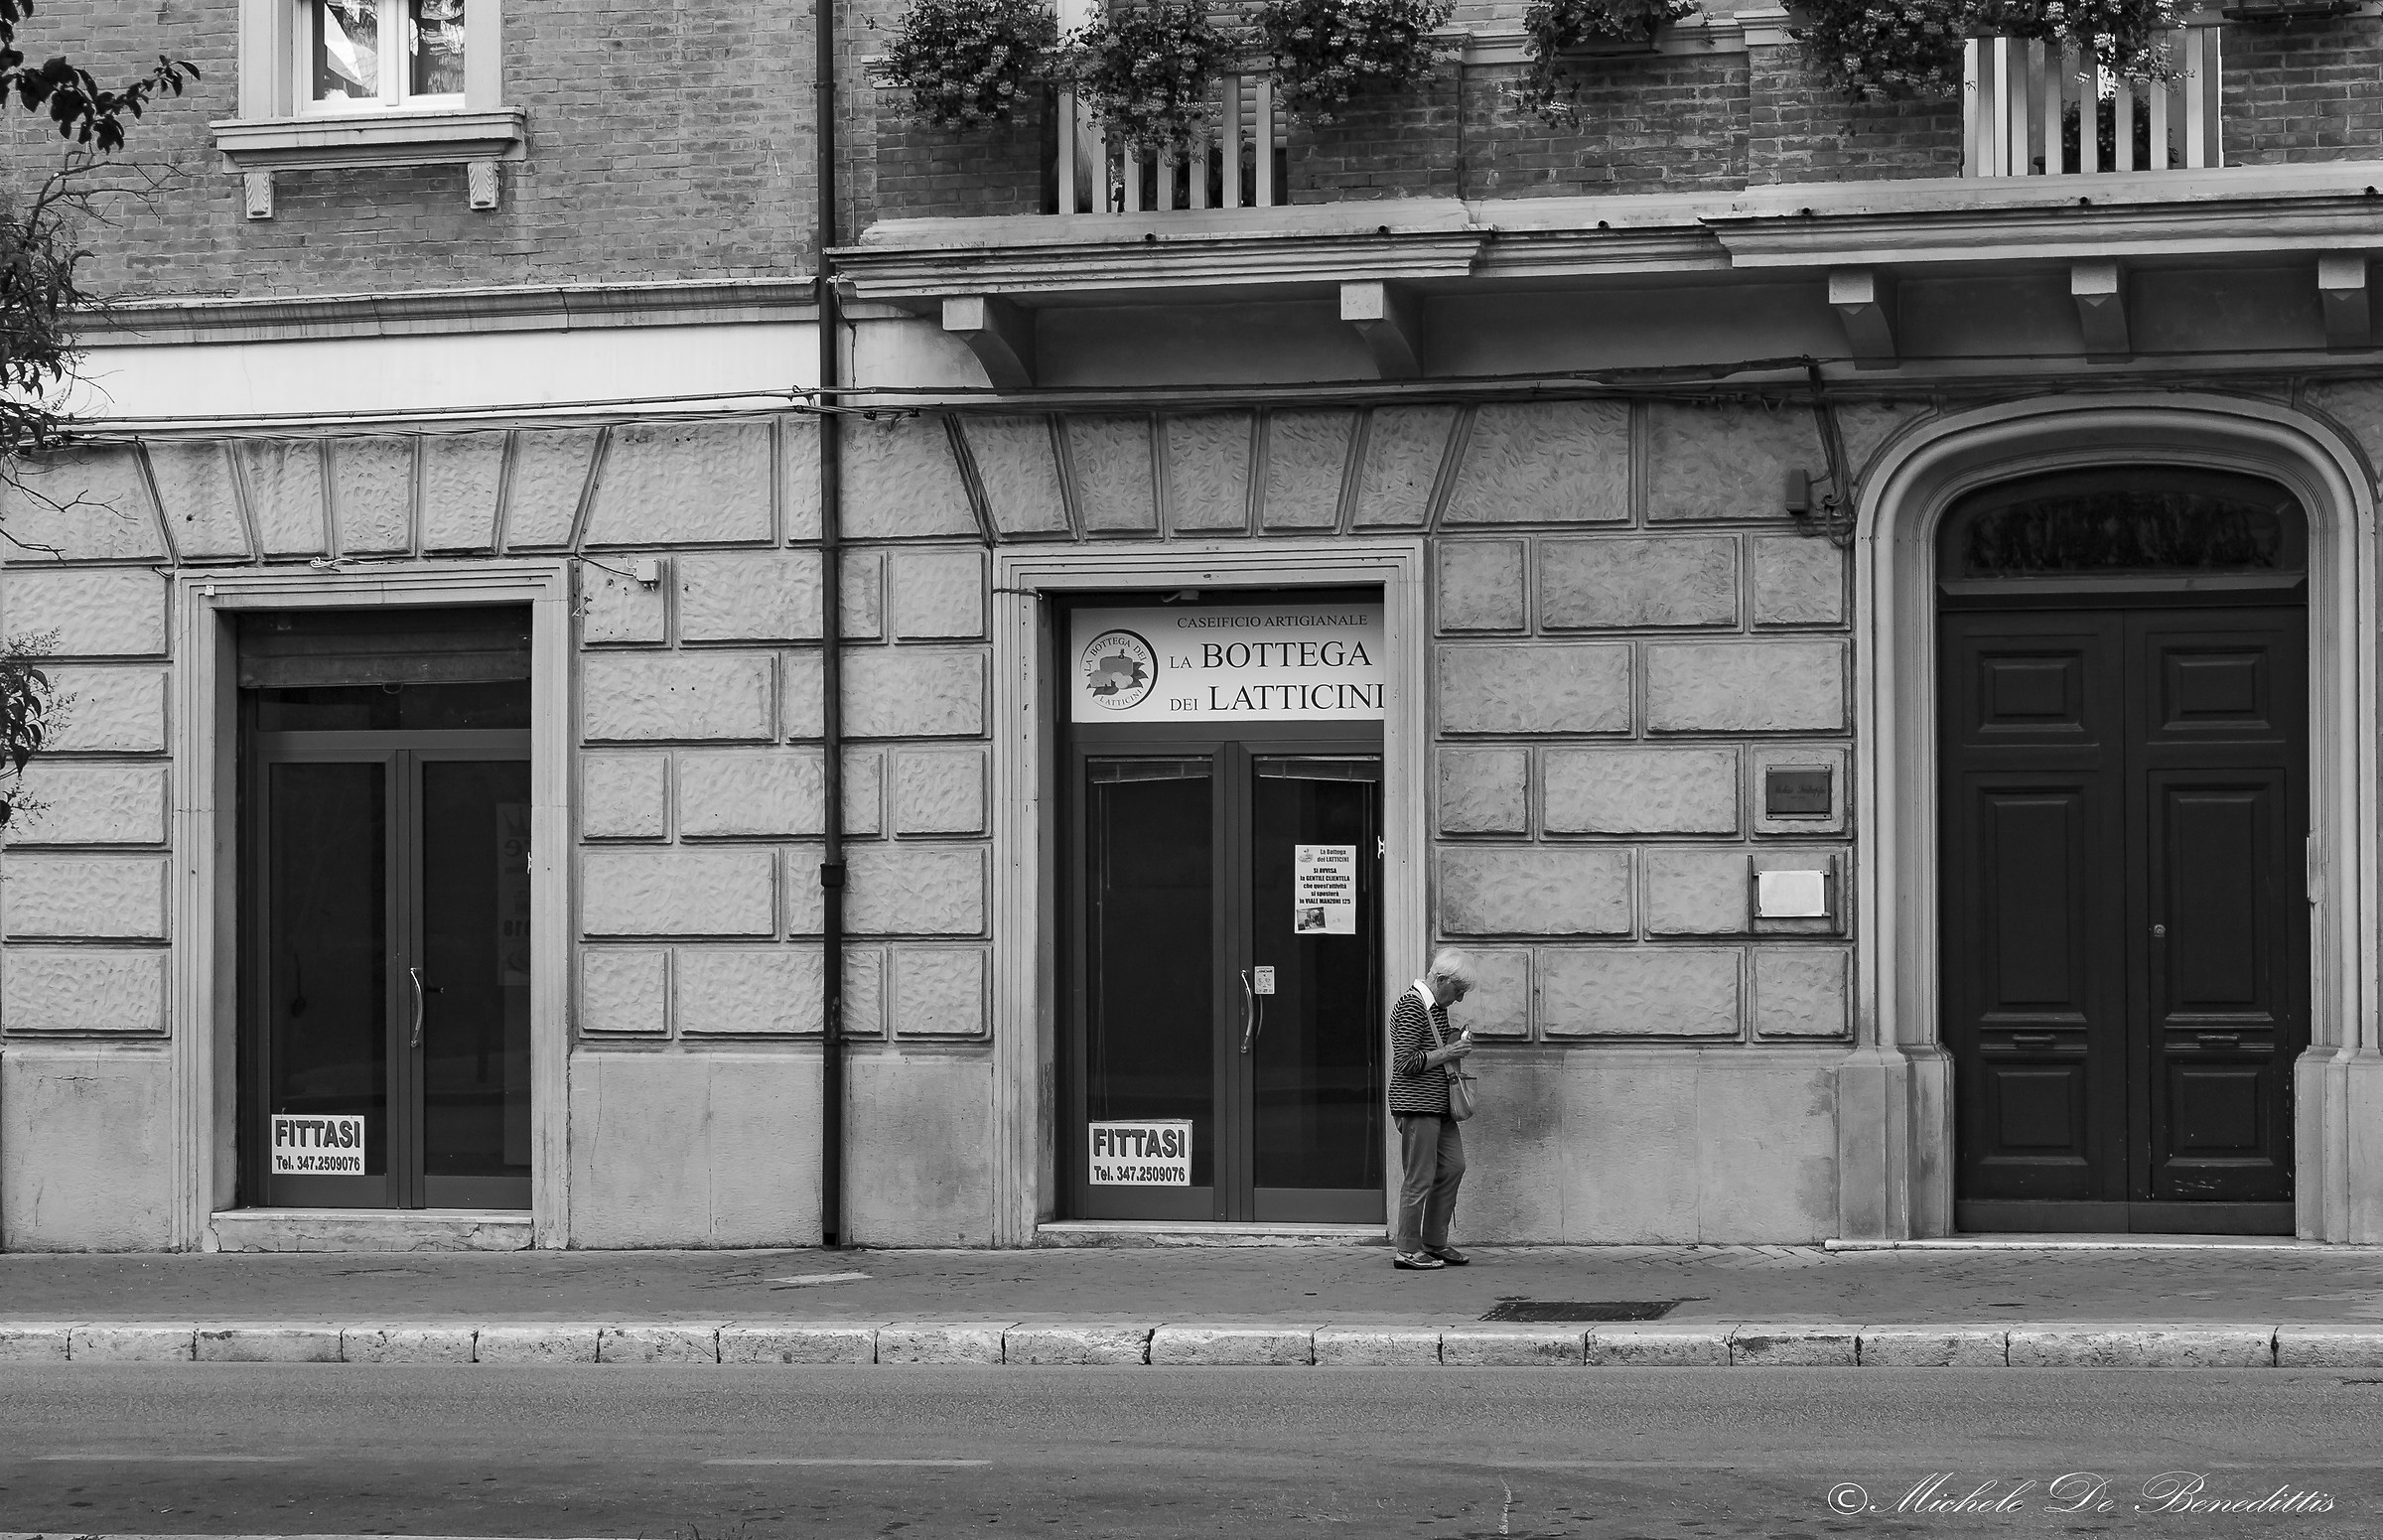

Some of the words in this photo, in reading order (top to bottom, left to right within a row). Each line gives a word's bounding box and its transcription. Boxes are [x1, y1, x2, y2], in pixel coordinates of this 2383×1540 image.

[1177, 617, 1262, 629] CASEIFICIO
[1265, 615, 1367, 628] ARTIGIANALE
[1083, 659, 1093, 672] LA
[1090, 636, 1131, 656] BOTTEGA
[1133, 645, 1147, 661] DEI
[1169, 655, 1192, 669] LA
[1200, 640, 1372, 669] BOTTEGA
[1099, 689, 1142, 706] LATTICINI
[1169, 698, 1198, 711] DEI
[1208, 683, 1384, 711] LATTICINI
[275, 1119, 360, 1149] FITTASI
[1093, 1128, 1186, 1158] FITTASI
[276, 1156, 294, 1170] Tel.
[297, 1156, 360, 1172] 347.2509076
[1094, 1165, 1114, 1182] Tel.
[1117, 1166, 1186, 1183] 347.2509076
